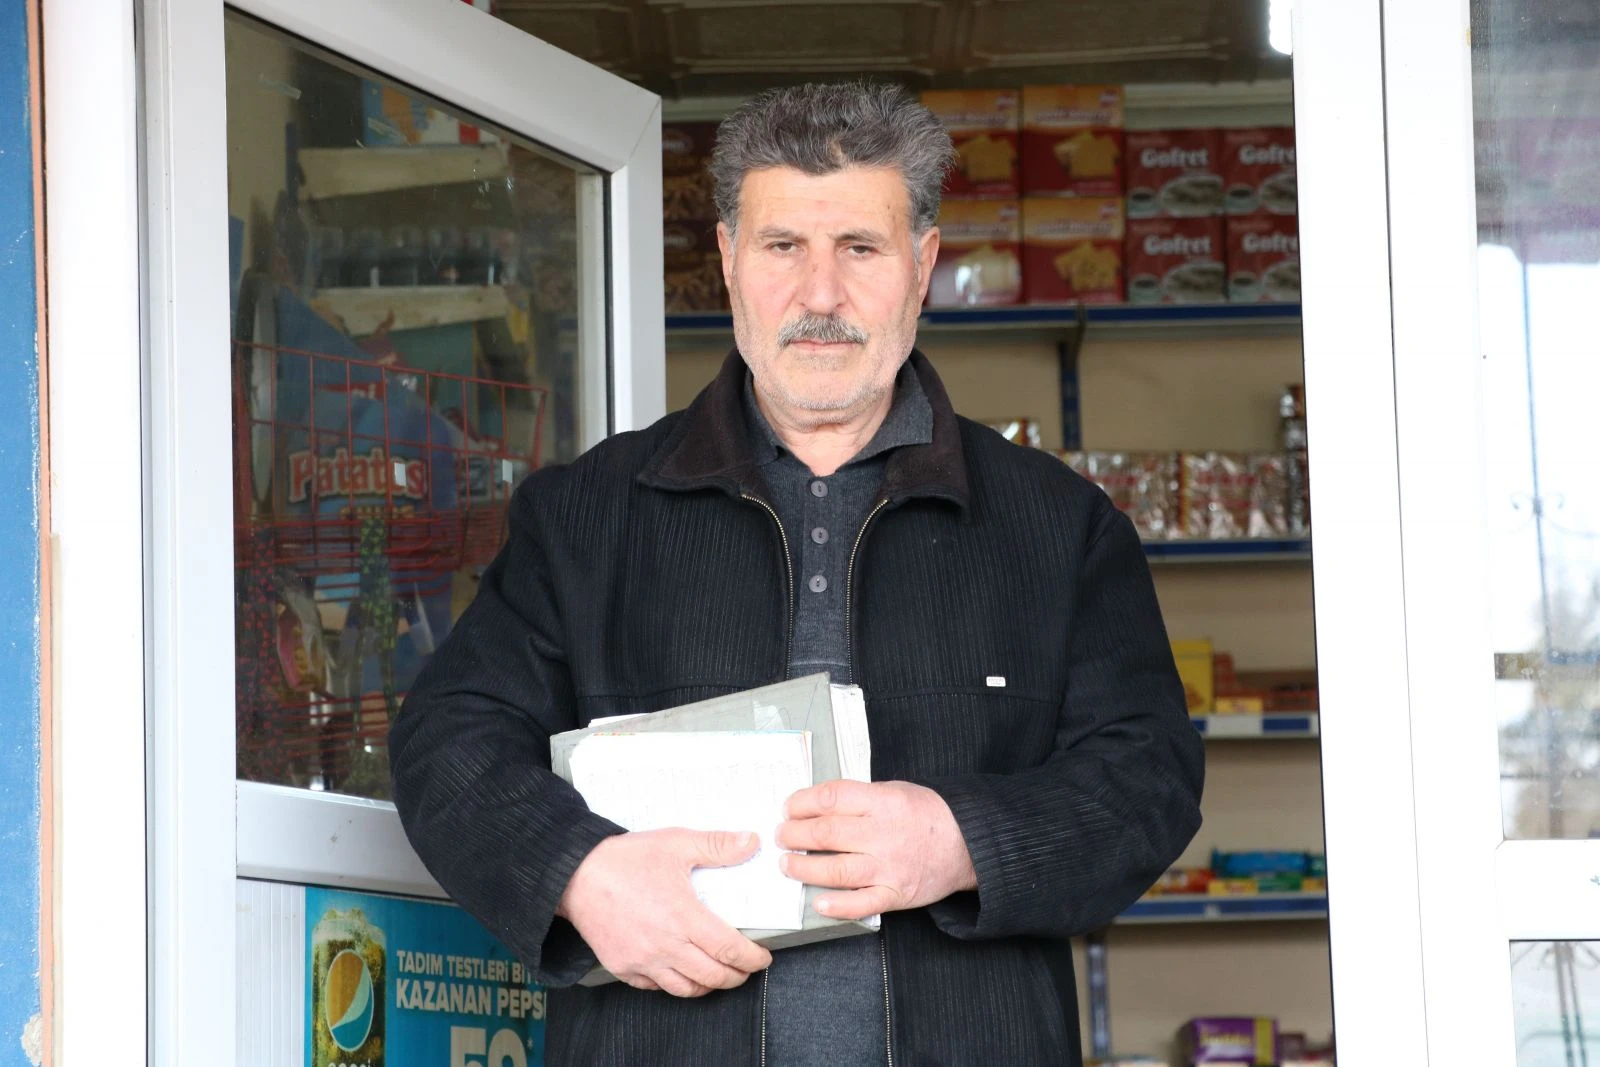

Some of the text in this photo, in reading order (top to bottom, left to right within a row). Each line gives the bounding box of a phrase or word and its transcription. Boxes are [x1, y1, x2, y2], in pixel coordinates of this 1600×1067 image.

[1140, 146, 1208, 168] Gofret
[1239, 143, 1295, 165] Gofre
[1143, 233, 1211, 256] Gofret
[1242, 230, 1298, 253] Gofre
[396, 949, 443, 976] TADIM
[396, 977, 492, 1016] KAZANAN
